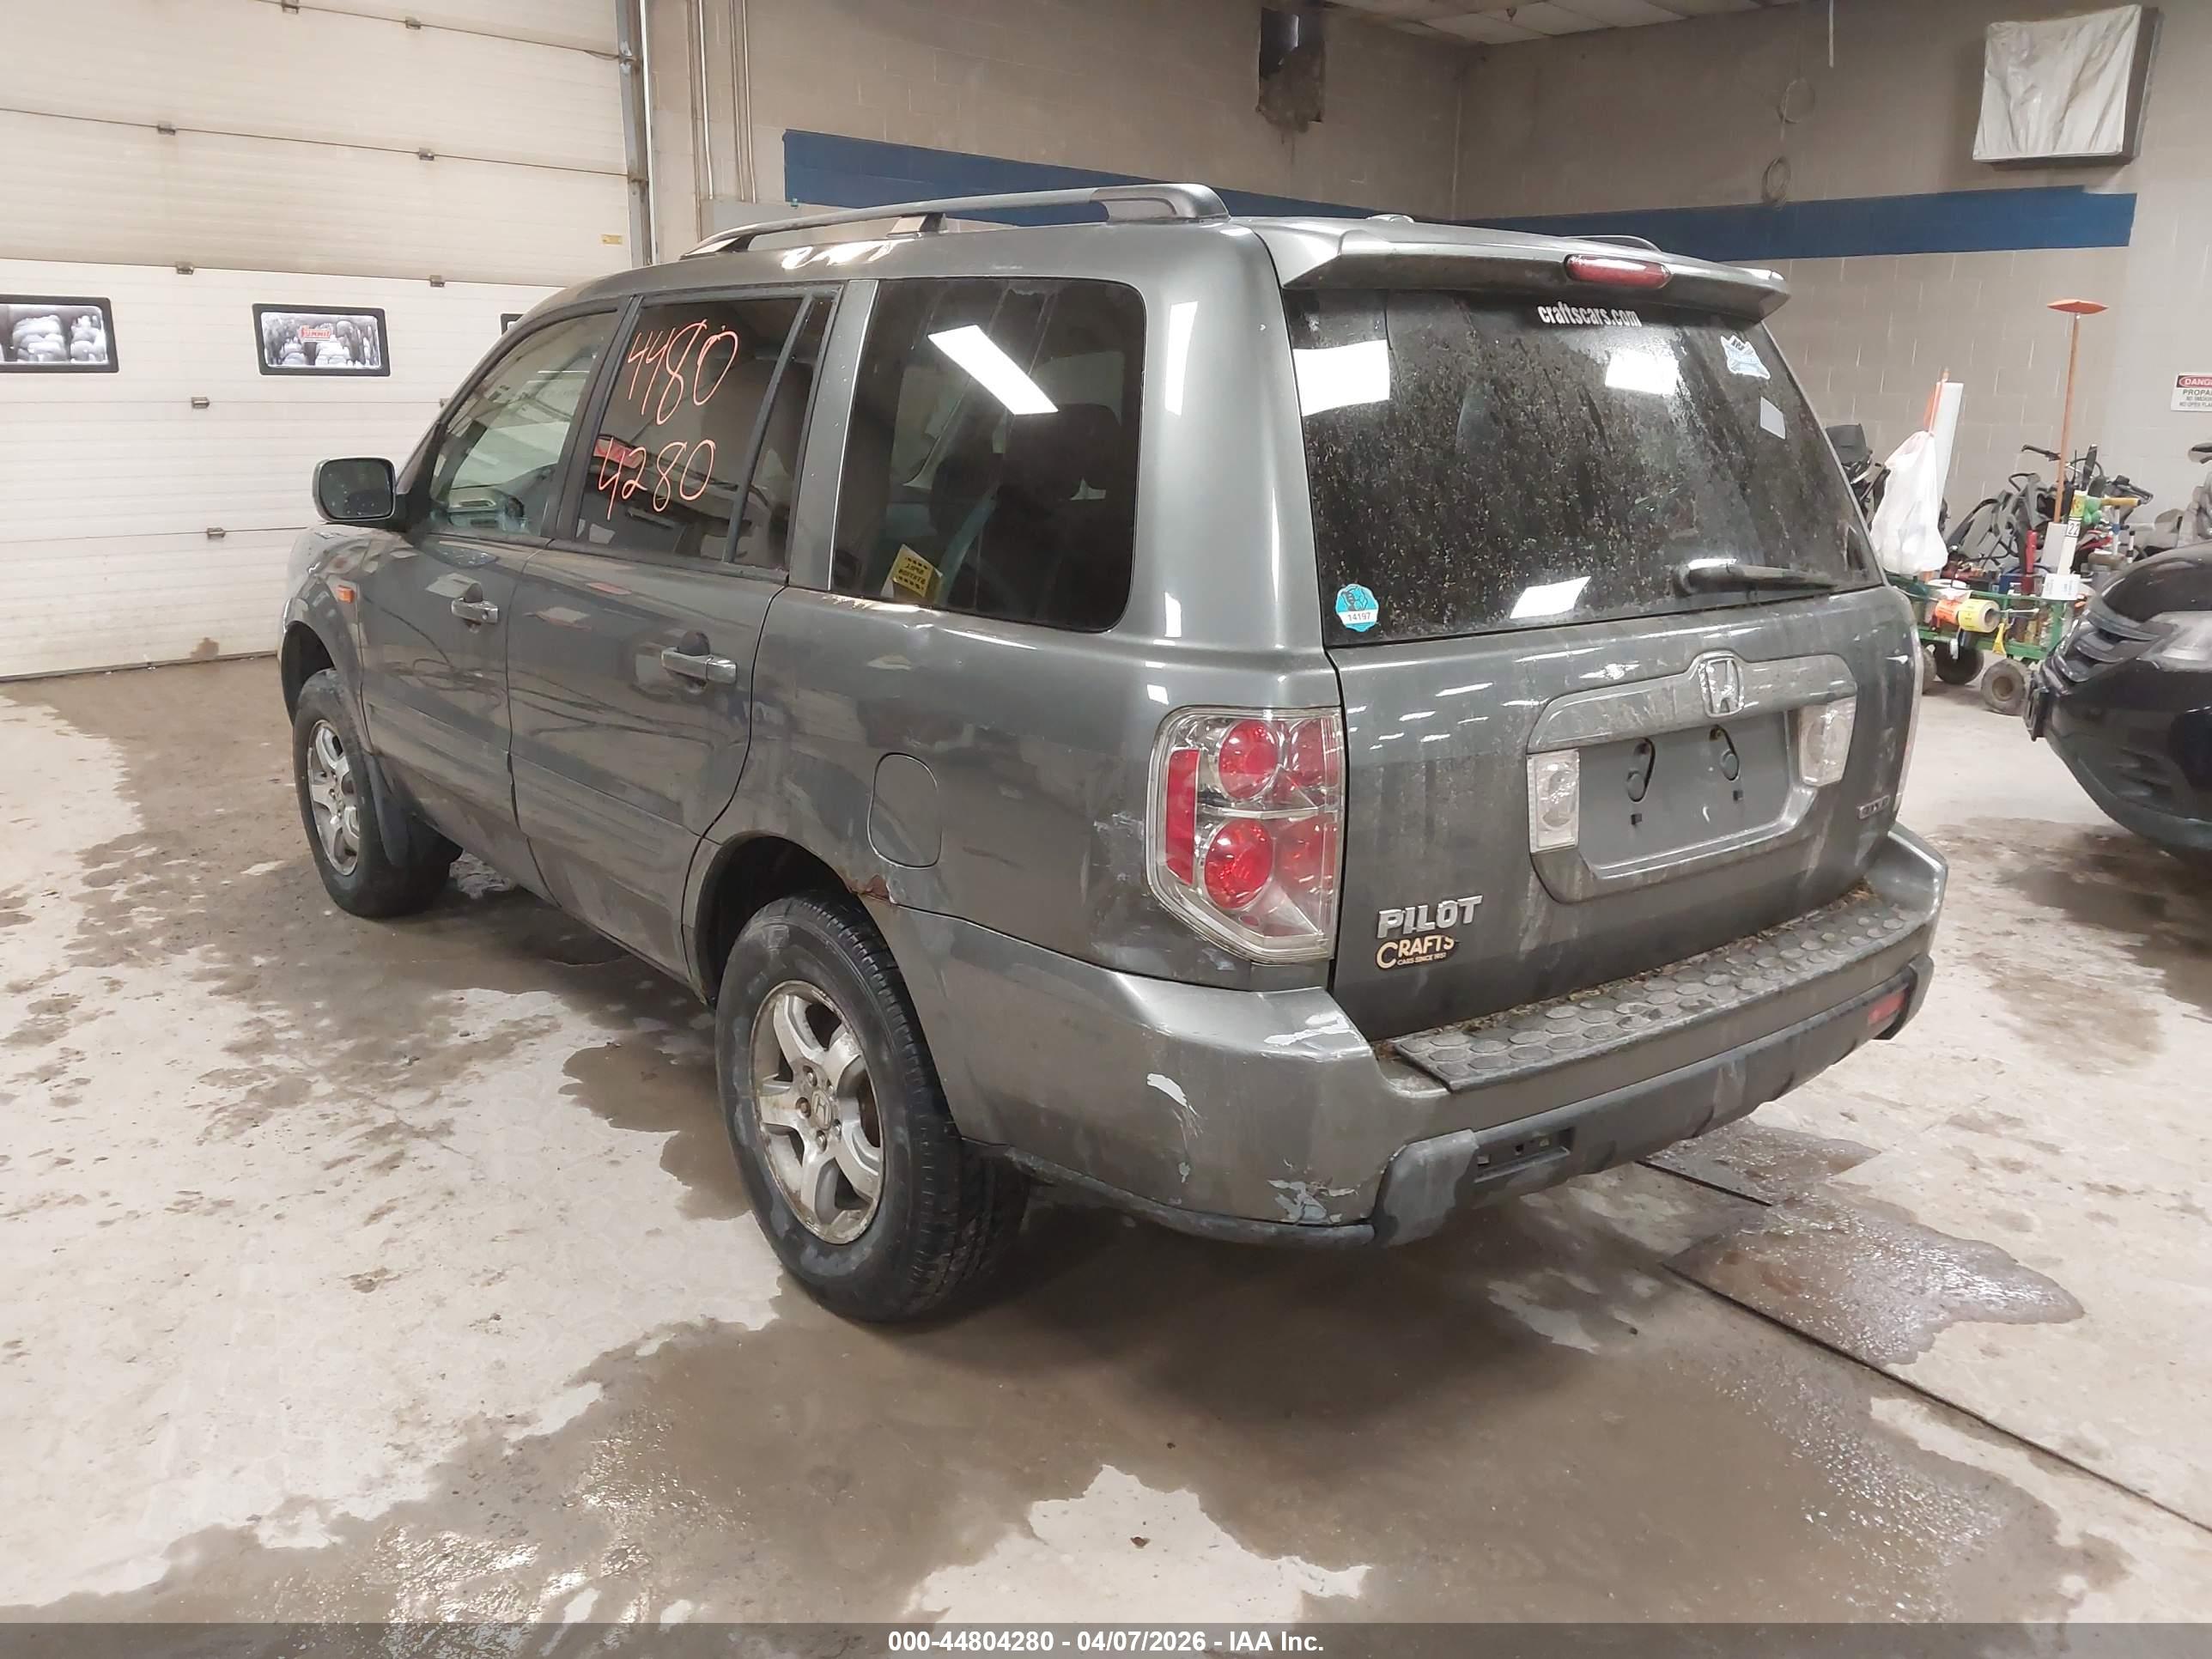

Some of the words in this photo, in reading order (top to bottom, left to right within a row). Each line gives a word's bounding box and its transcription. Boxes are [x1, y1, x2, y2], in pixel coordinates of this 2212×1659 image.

[1537, 301, 1642, 326] craftscars.com
[627, 319, 738, 426] 4480
[598, 438, 717, 520] 4280
[1347, 611, 1371, 622] 14197
[1376, 895, 1484, 939] PILOT
[1376, 934, 1455, 969] CRAFTS
